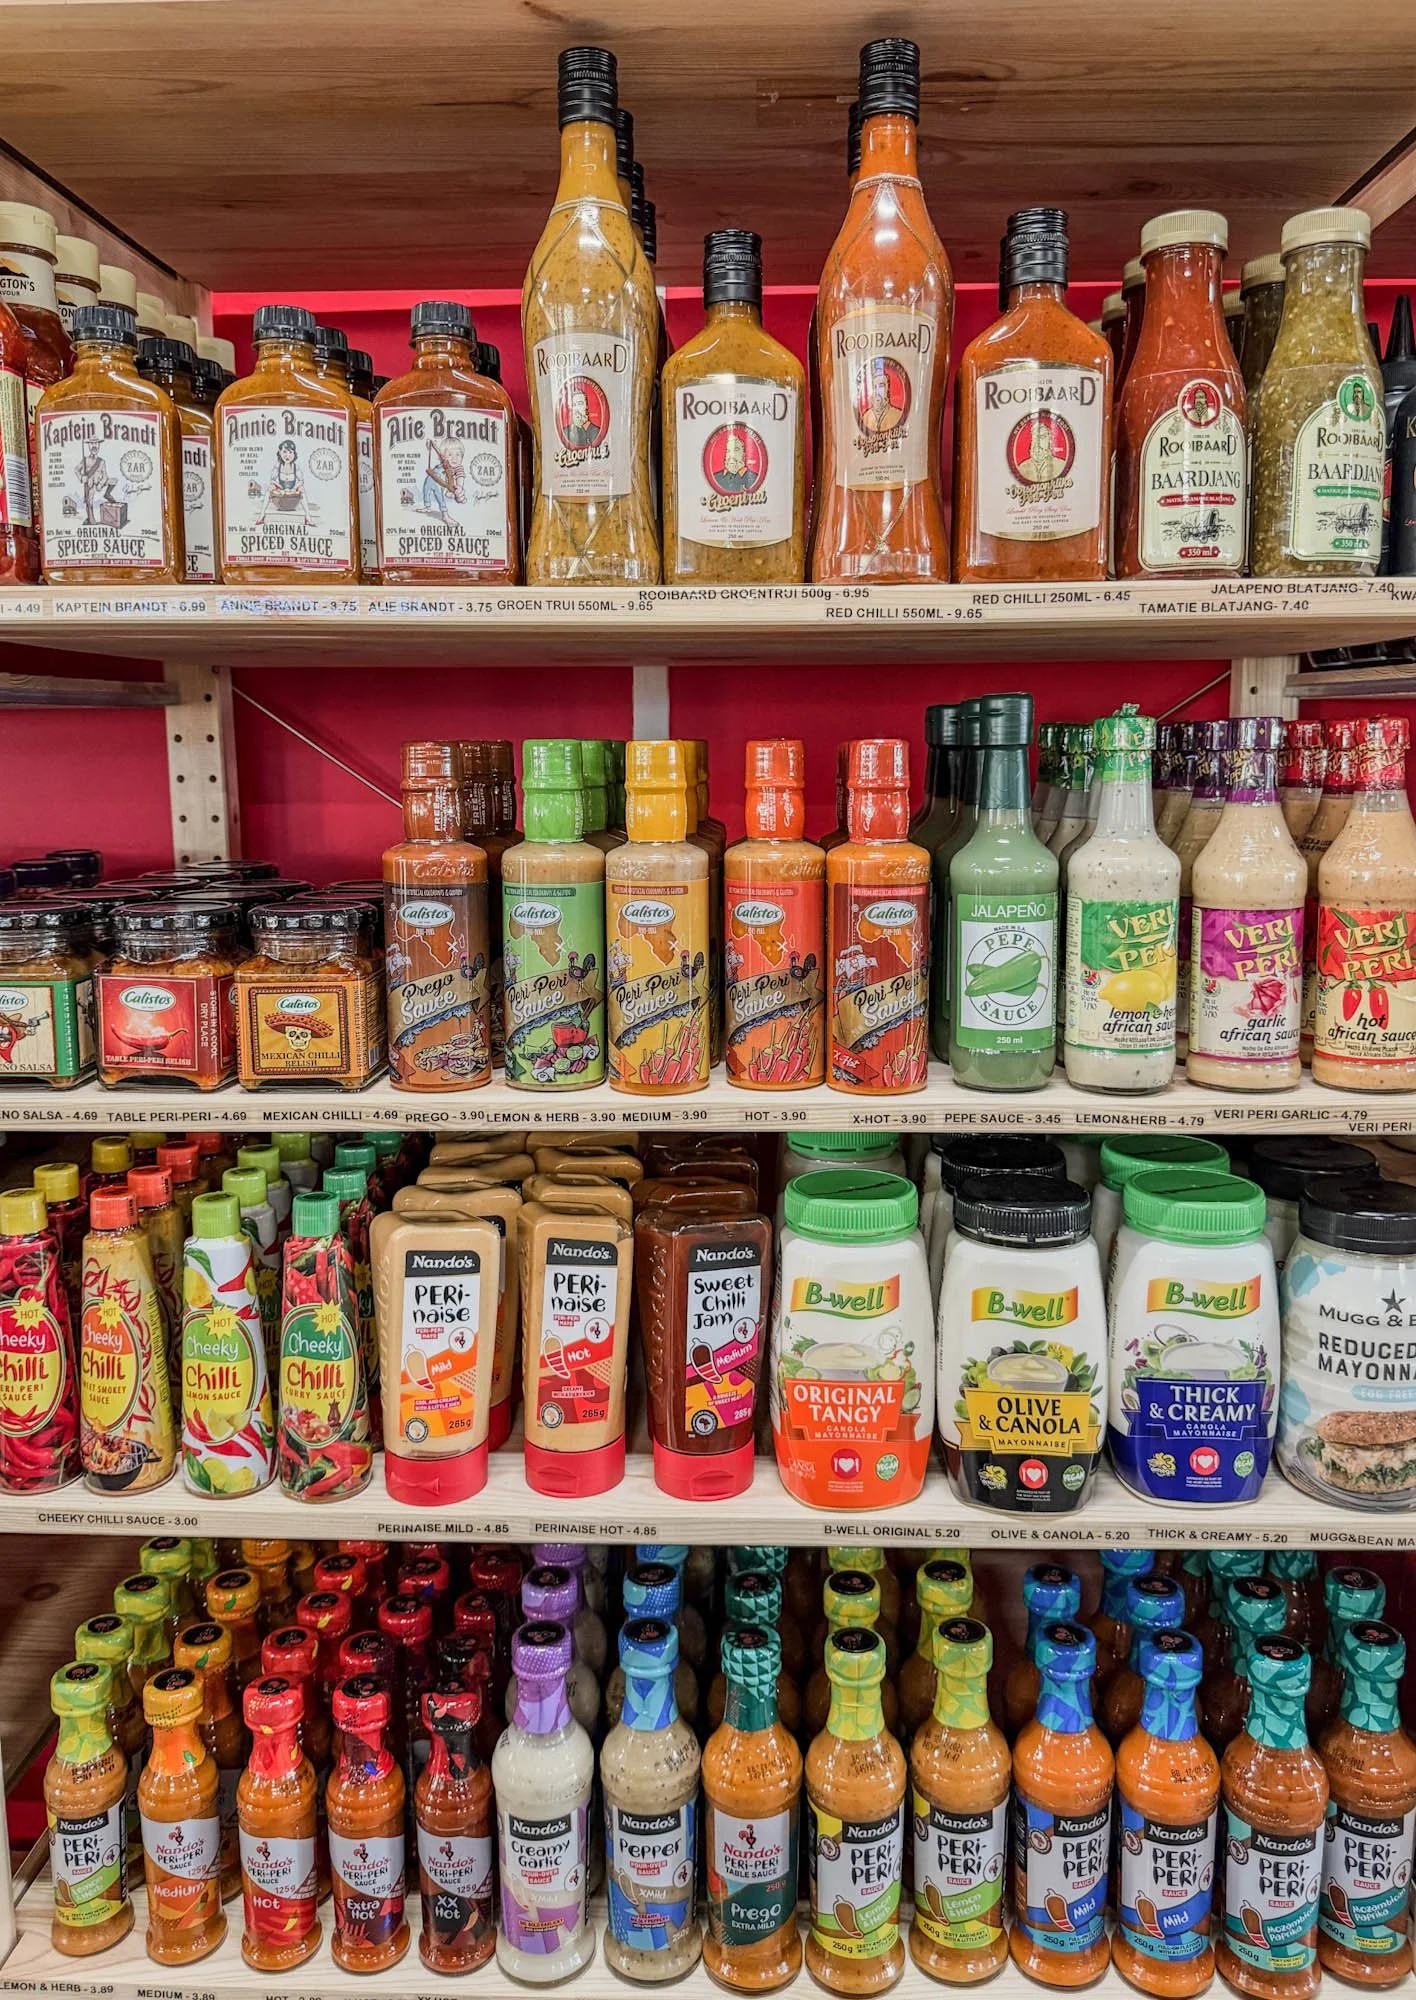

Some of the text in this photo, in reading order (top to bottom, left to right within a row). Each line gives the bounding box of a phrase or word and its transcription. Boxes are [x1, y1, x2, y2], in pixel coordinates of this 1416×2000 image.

[43, 413, 157, 450] Kaptein Brandt
[227, 410, 345, 447] Annie Brandt
[387, 409, 498, 449] Alie Brandt
[1151, 470, 1241, 490] BAARDJANG
[420, 526, 466, 537] ORIGINAL
[399, 537, 490, 558] SPICED SAUCE
[639, 590, 716, 600] ROOIBAARD
[801, 588, 831, 600] 500g
[842, 588, 869, 598] 6.95
[1210, 584, 1283, 594] JALAPENO
[1367, 582, 1395, 593] 7.40
[972, 591, 1131, 604] RED CHILLI 250ML 6.45
[14, 603, 41, 613] 4.49
[56, 602, 206, 612] KAPTEIN BRANDT 6.99
[264, 600, 319, 612] BRANDT
[330, 601, 356, 612] 3.75
[400, 602, 455, 612] BRANDT
[466, 602, 493, 612] 3.75
[497, 601, 653, 611] GROEN TRUI 550ML 9.65
[826, 607, 982, 619] RED CHILLI 550ML 9.65
[1140, 603, 1197, 613] TAMATIE
[971, 902, 1046, 918] JALAPEÑO
[1334, 917, 1408, 949] VERI
[985, 933, 1036, 951] PEPE
[1341, 950, 1415, 981] PERI
[402, 974, 456, 1003] Prego
[401, 991, 458, 1025] Sauce
[512, 991, 565, 1023] Sauce
[980, 1000, 1038, 1021] SAUCE
[1247, 1015, 1286, 1033] garlic
[1357, 1013, 1386, 1029] hot
[1220, 1028, 1271, 1044] african
[23, 1110, 98, 1120] SALSA 4.69
[106, 1111, 247, 1122] TABLE PERI-PERI 4.69
[263, 1110, 398, 1121] MEXICAN CHILLI 4.69
[405, 1110, 485, 1123] PREGO 3.90
[486, 1112, 616, 1122] LEMON & HERB 3.90
[622, 1110, 707, 1122] MEDIUM 3.90
[744, 1110, 807, 1121] HOT 3.90
[853, 1114, 927, 1124] X-HOT 3.90
[944, 1113, 1061, 1124] PEPE SAUCE 3.45
[1076, 1114, 1204, 1126] LEMON&HERB 4.79
[1214, 1109, 1368, 1120] VERI PERI GARLIC 4.79
[1349, 1122, 1412, 1132] VERI PERI
[412, 1254, 477, 1270] Nando's
[694, 1275, 755, 1294] Sweet
[702, 1293, 746, 1313] Chilli
[805, 1281, 885, 1311] B-well
[1165, 1281, 1247, 1312] B-well
[212, 1317, 233, 1328] HOT
[413, 1307, 471, 1325] naise
[692, 1311, 734, 1330] Jam
[288, 1332, 344, 1361] Cheeky
[567, 1348, 592, 1362] Hot
[286, 1361, 345, 1391] Chilli
[793, 1384, 897, 1405] ORIGINAL
[1170, 1385, 1240, 1404] THICK
[808, 1404, 882, 1424] TANGY
[997, 1396, 1062, 1417] OLIVE
[1149, 1403, 1257, 1423] & CREAMY
[979, 1415, 1081, 1435] & CANOLA
[38, 1513, 198, 1526] CHEEKY CHILLI SAUCE 3.00
[378, 1523, 509, 1533] PERINAISE MILD 4.85
[535, 1523, 657, 1536] PERINAISE HOT 4.85
[824, 1525, 960, 1538] B-WELL ORIGINAL 5.20
[991, 1530, 1130, 1541] OLIVE & CANOLA 5.20
[1148, 1528, 1288, 1544] THICK & CREAMY 5.20
[1310, 1533, 1394, 1546] MUGG&BEAN
[512, 1820, 568, 1836] Nando's
[156, 1836, 206, 1855] Nando's
[511, 1839, 571, 1859] Creamy
[619, 1838, 682, 1858] Pepper
[1256, 1833, 1313, 1852] Nando's
[518, 1854, 563, 1870] Garlic
[153, 1877, 206, 1898] Medium
[347, 1898, 381, 1911] Extra
[730, 1902, 783, 1923] Prego
[351, 1909, 376, 1920] Hot
[1163, 1913, 1190, 1928] Mild
[731, 1919, 776, 1931] EXTRA MILD
[39, 1982, 114, 1994] & HERB 3.89
[137, 1989, 183, 1999] MEDIUM
